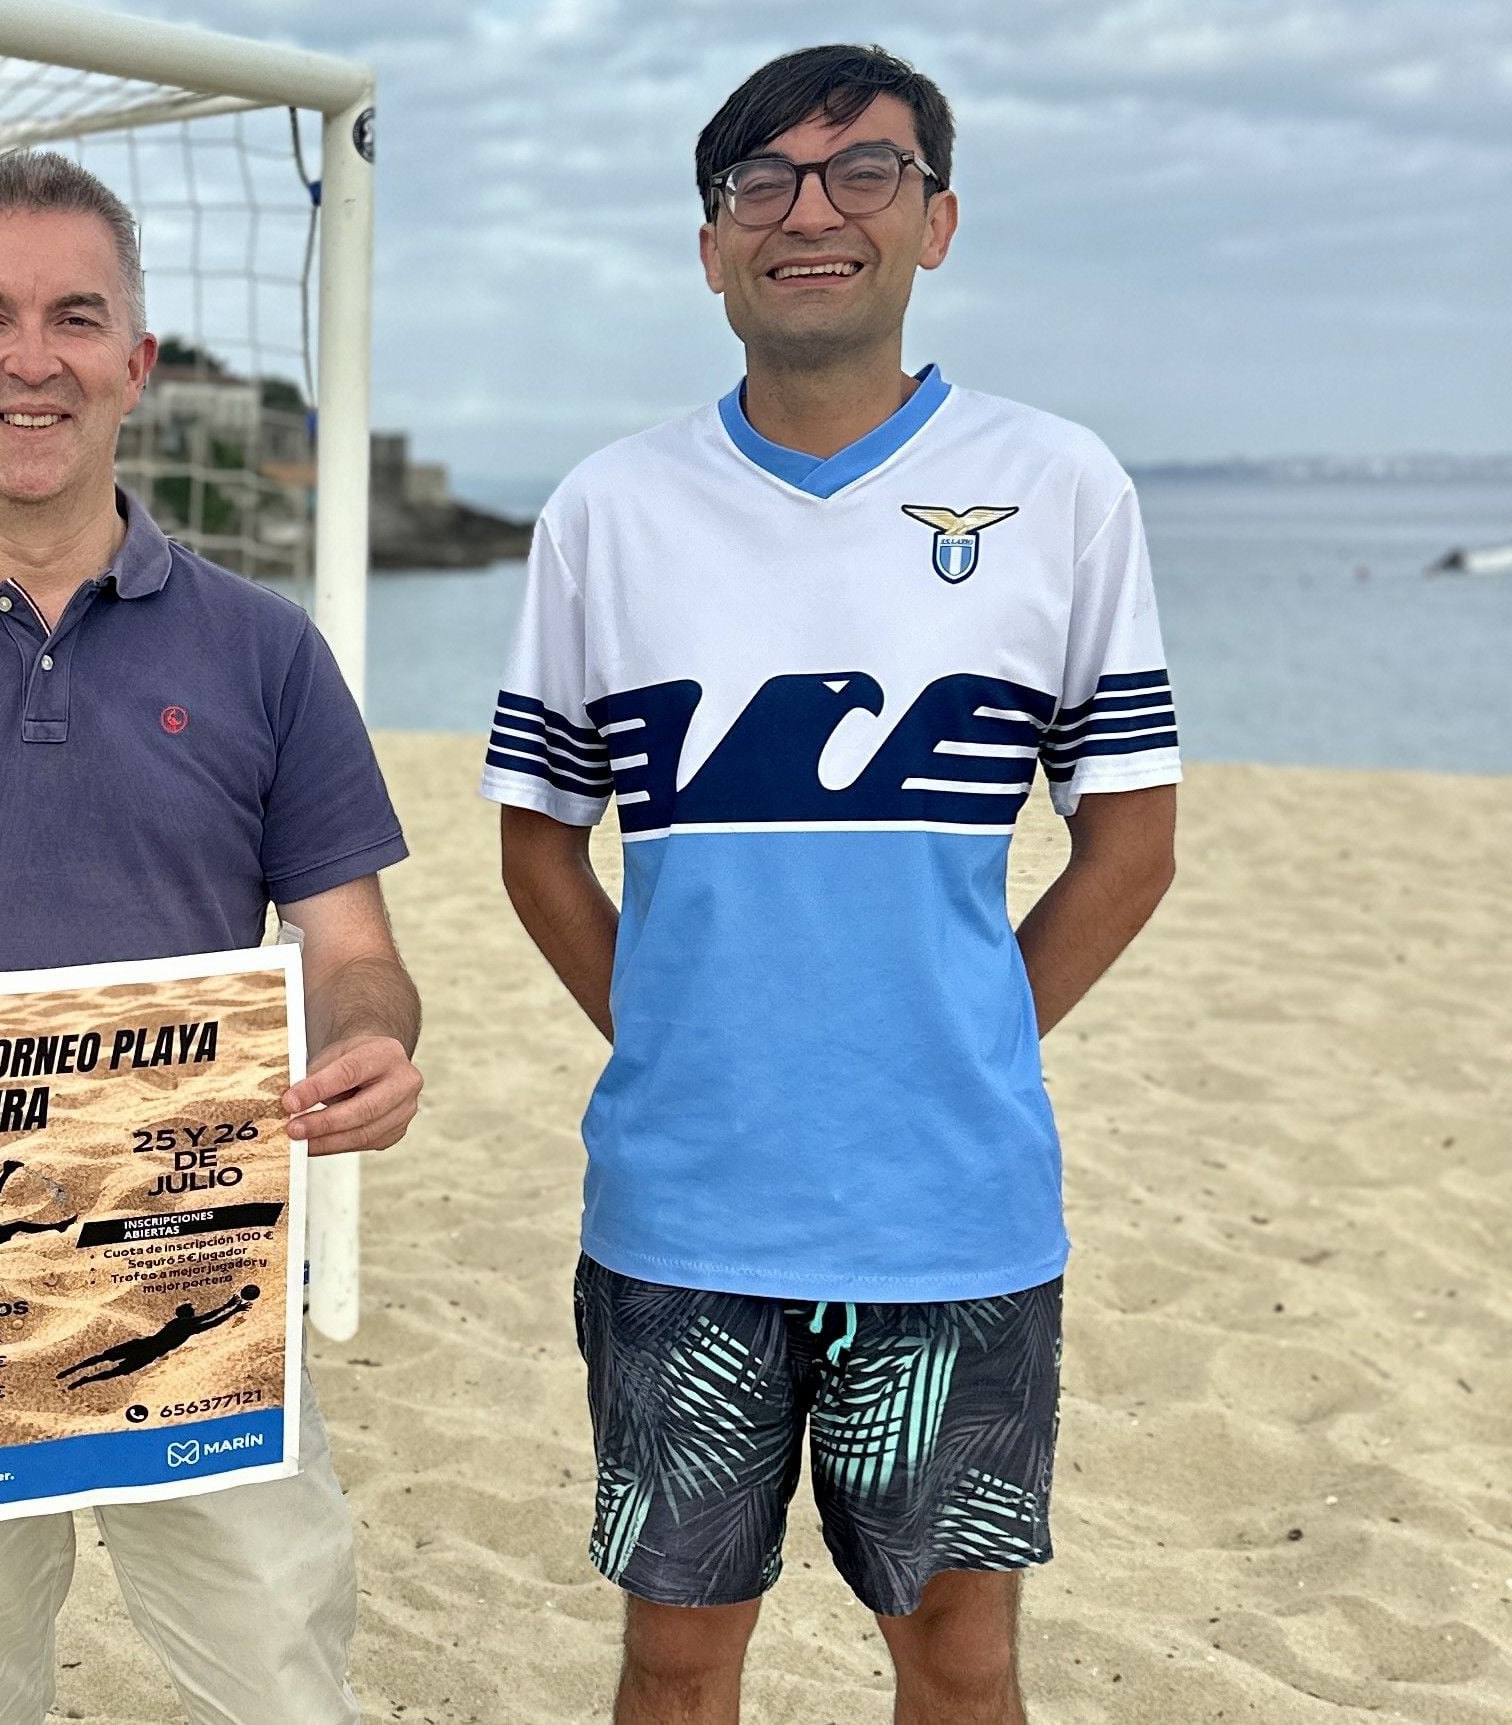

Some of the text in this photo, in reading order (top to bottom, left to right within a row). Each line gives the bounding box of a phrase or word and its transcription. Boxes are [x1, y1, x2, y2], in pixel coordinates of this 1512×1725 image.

[109, 1021, 219, 1070] PLAYA
[132, 1120, 259, 1153] 25 Y 26
[174, 1147, 218, 1171] DE
[147, 1166, 243, 1196] JULIO
[123, 1225, 180, 1240] ABIERTAS
[124, 1211, 214, 1229] INSCRIPCIONES
[103, 1230, 274, 1259] Cuota de inscripción 100 €
[197, 1247, 248, 1263] jugador
[111, 1257, 268, 1284] Trofeo a mejor jugador y
[143, 1274, 233, 1294] mejor portero
[159, 1390, 262, 1418] 656377121
[203, 1433, 263, 1455] MARÍN
